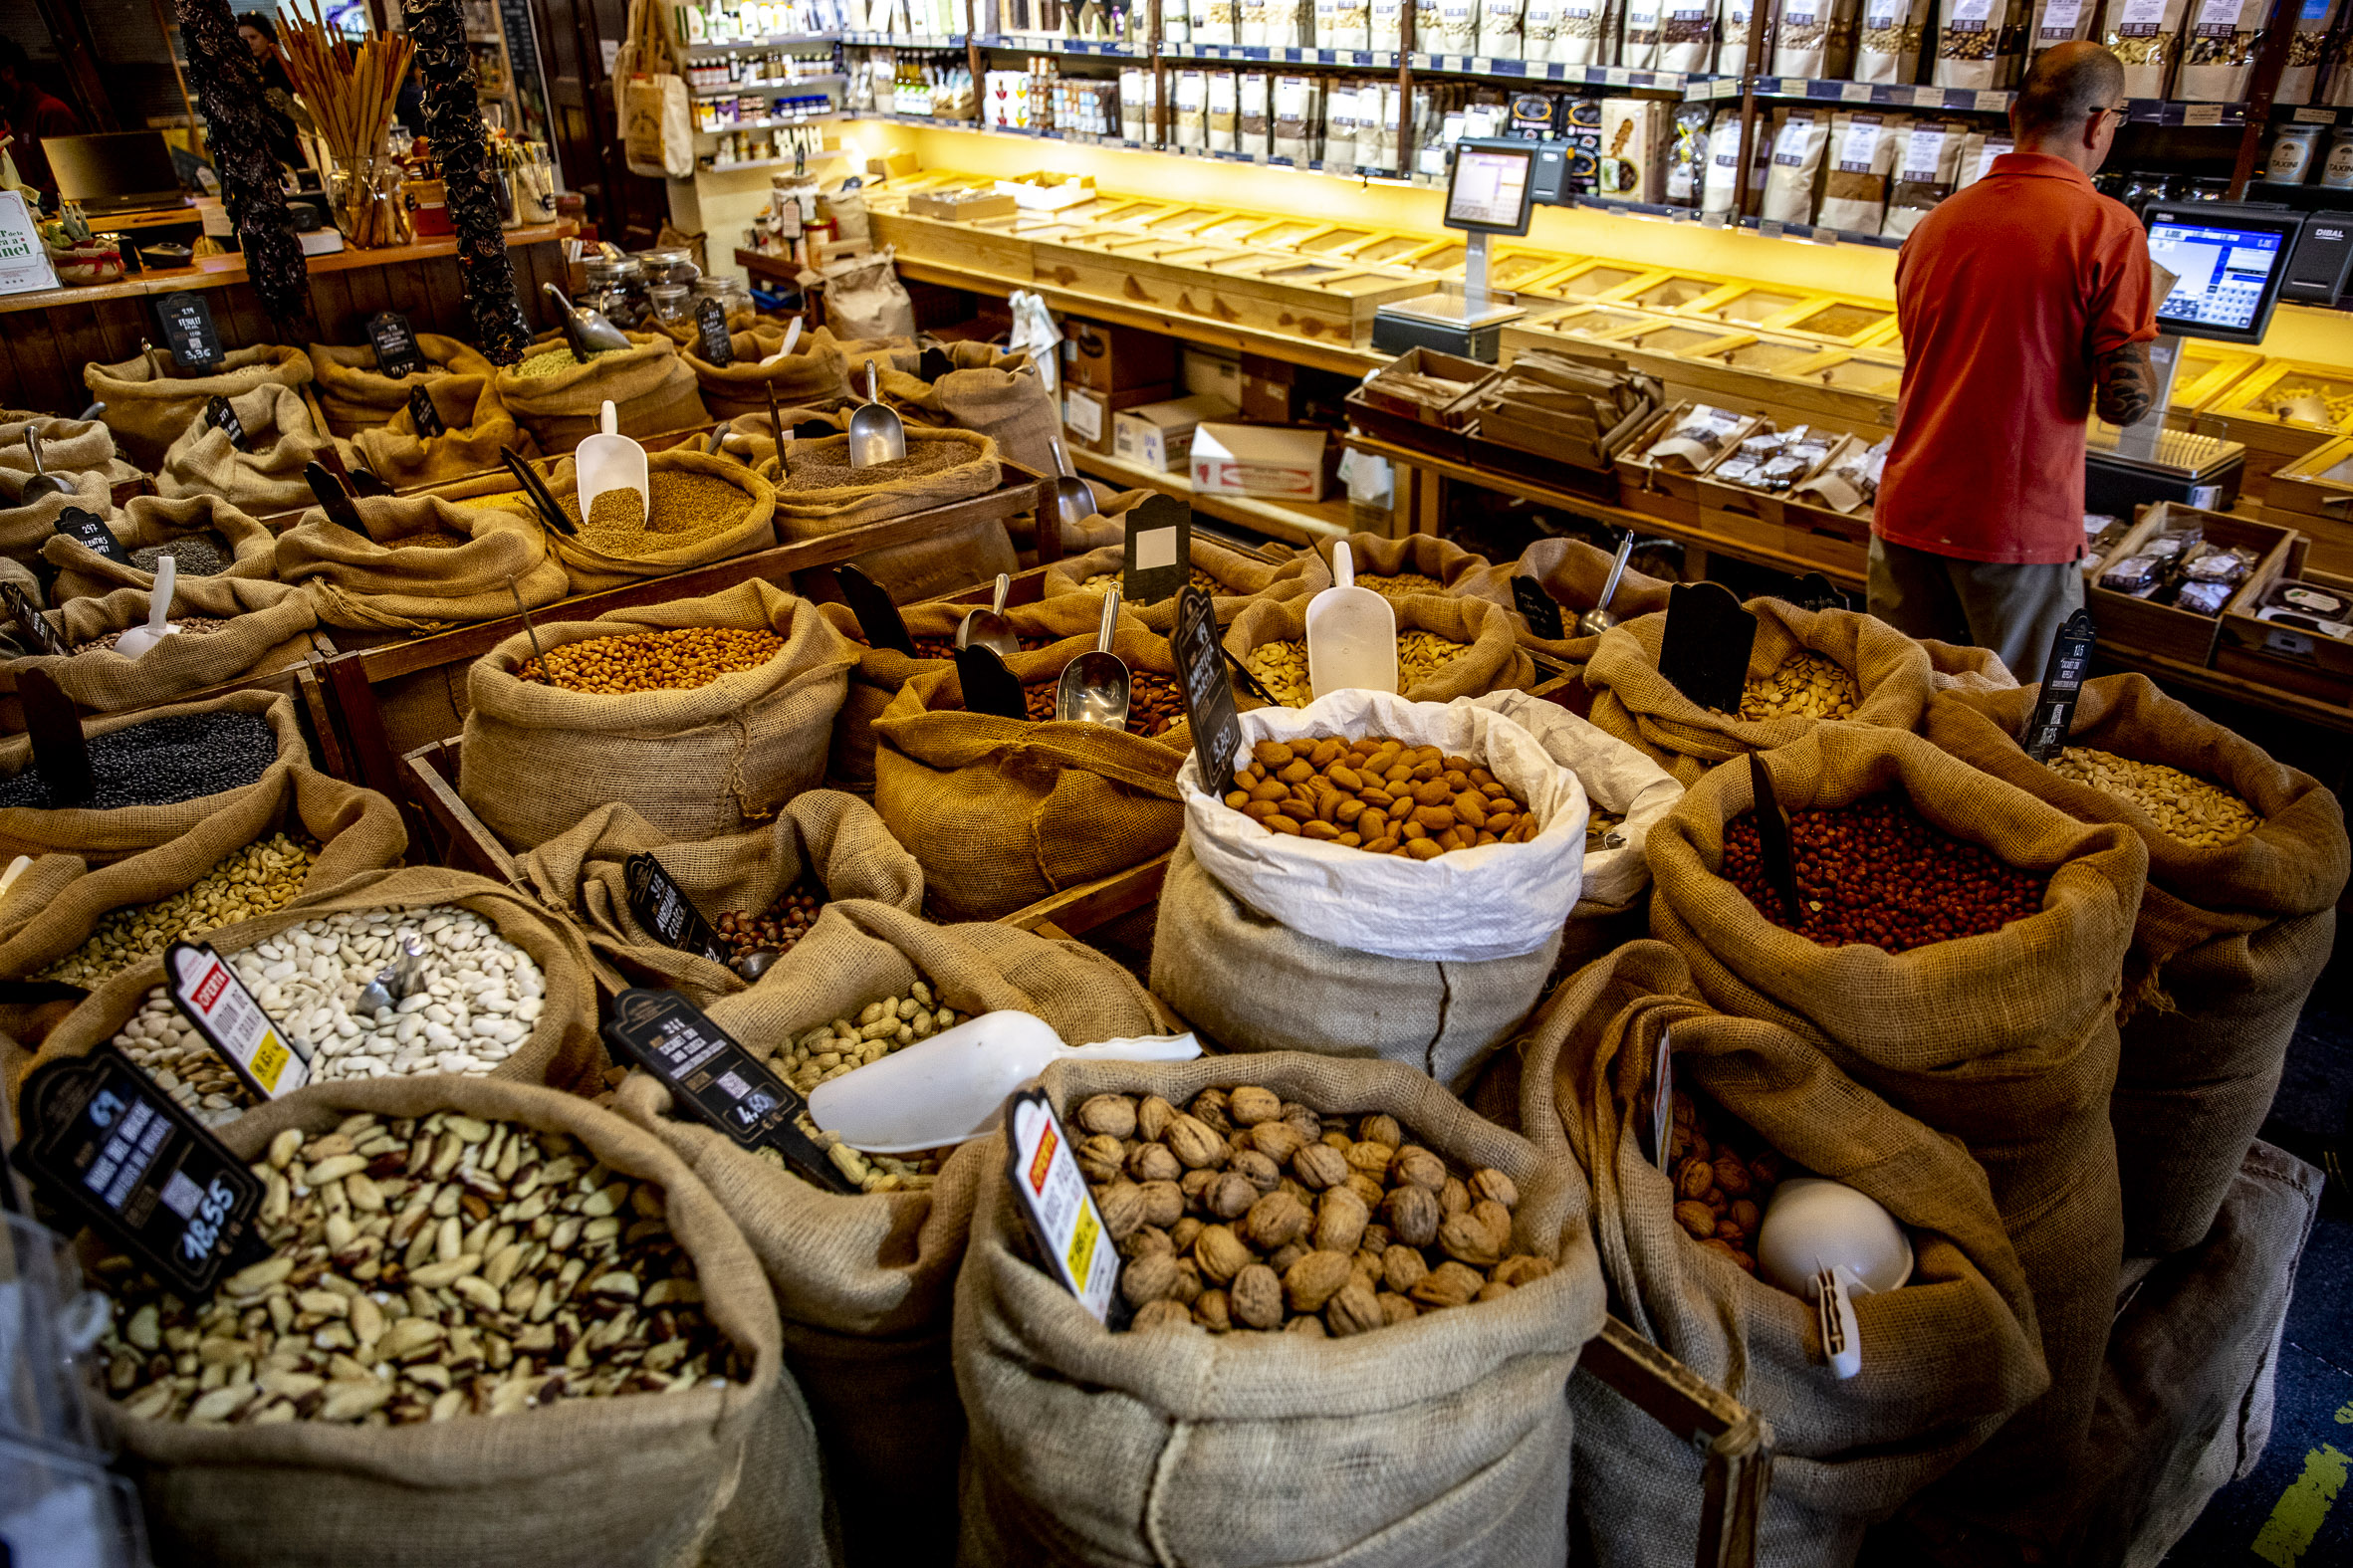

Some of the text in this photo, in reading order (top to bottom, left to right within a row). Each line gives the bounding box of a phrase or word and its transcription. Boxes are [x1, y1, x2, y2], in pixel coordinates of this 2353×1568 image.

[2315, 228, 2344, 238] DIBAL
[81, 523, 99, 535] 297
[196, 970, 227, 1009] OFERTA
[182, 1178, 235, 1260] 18,55
